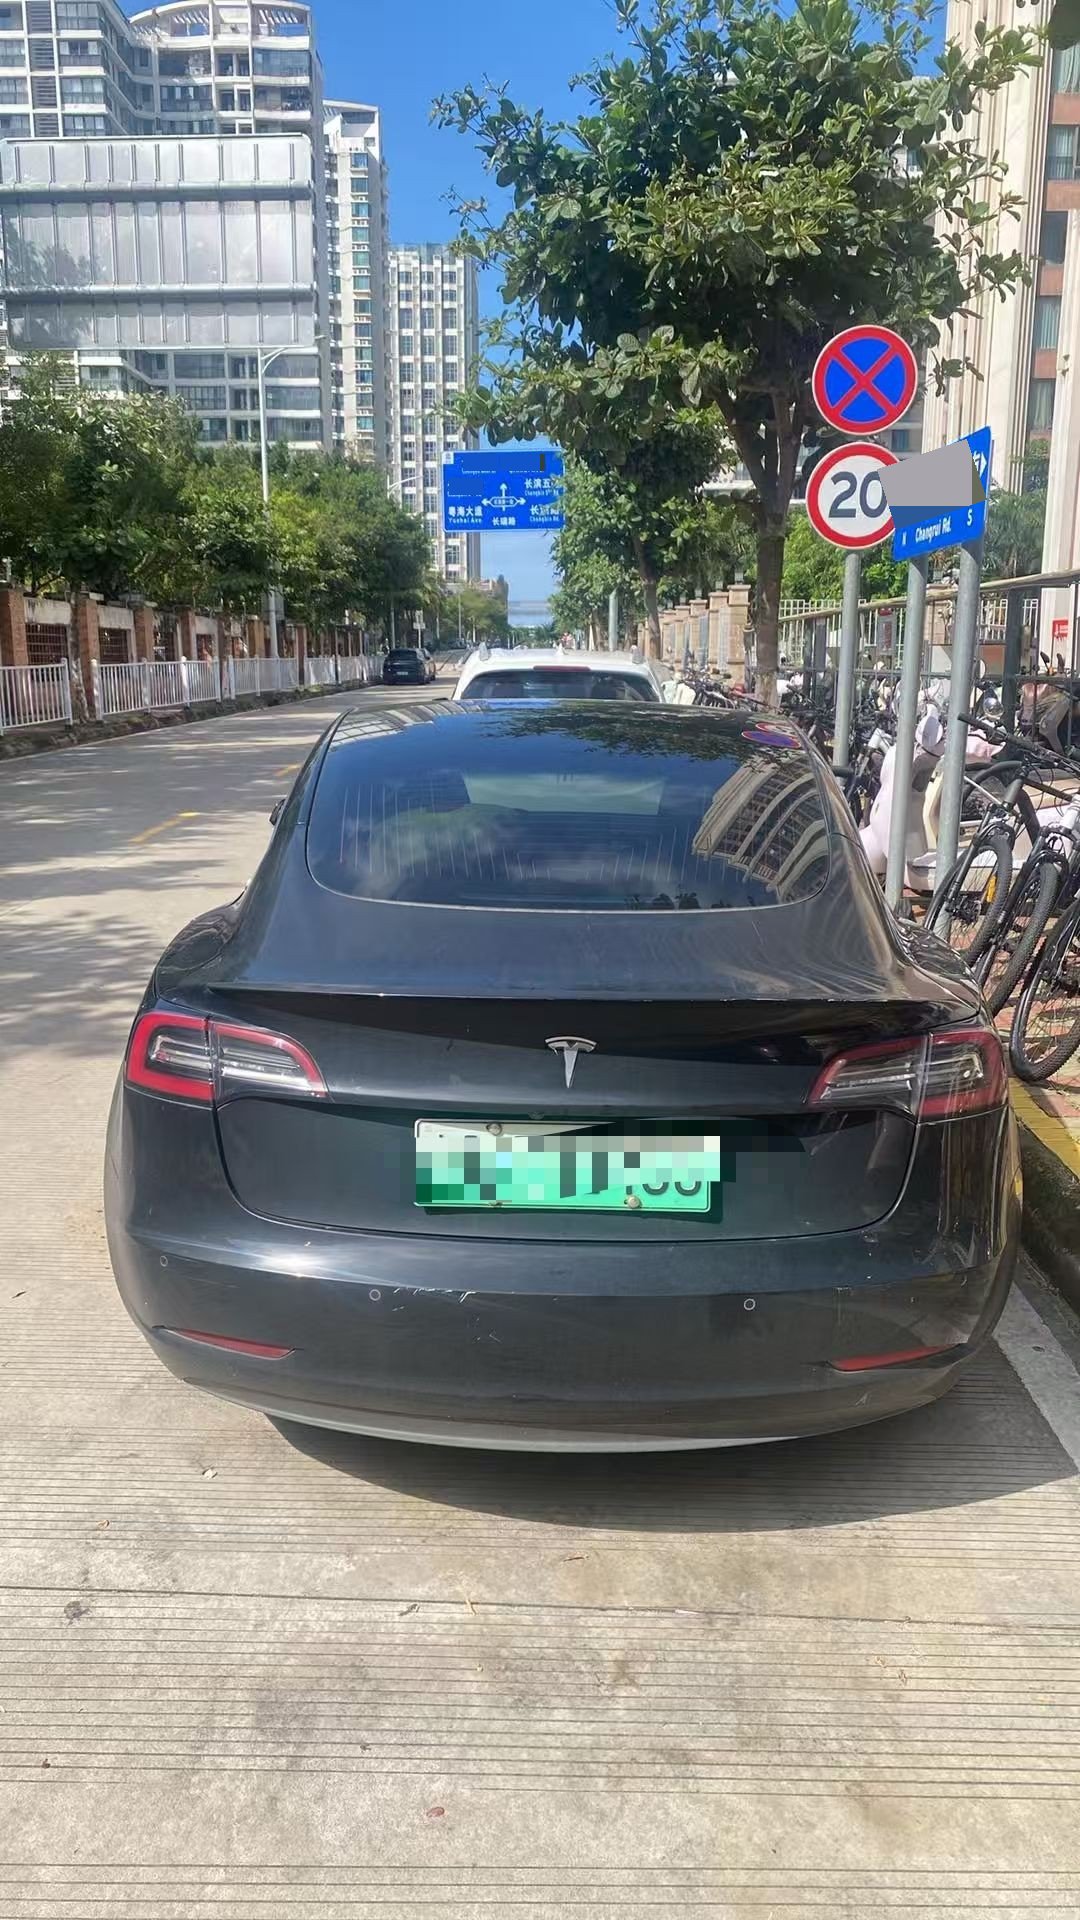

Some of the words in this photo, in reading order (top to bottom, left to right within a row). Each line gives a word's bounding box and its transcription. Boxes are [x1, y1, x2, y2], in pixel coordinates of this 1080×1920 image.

[829, 471, 887, 519] 20
[915, 520, 942, 543] Changrui
[966, 508, 973, 526] S
